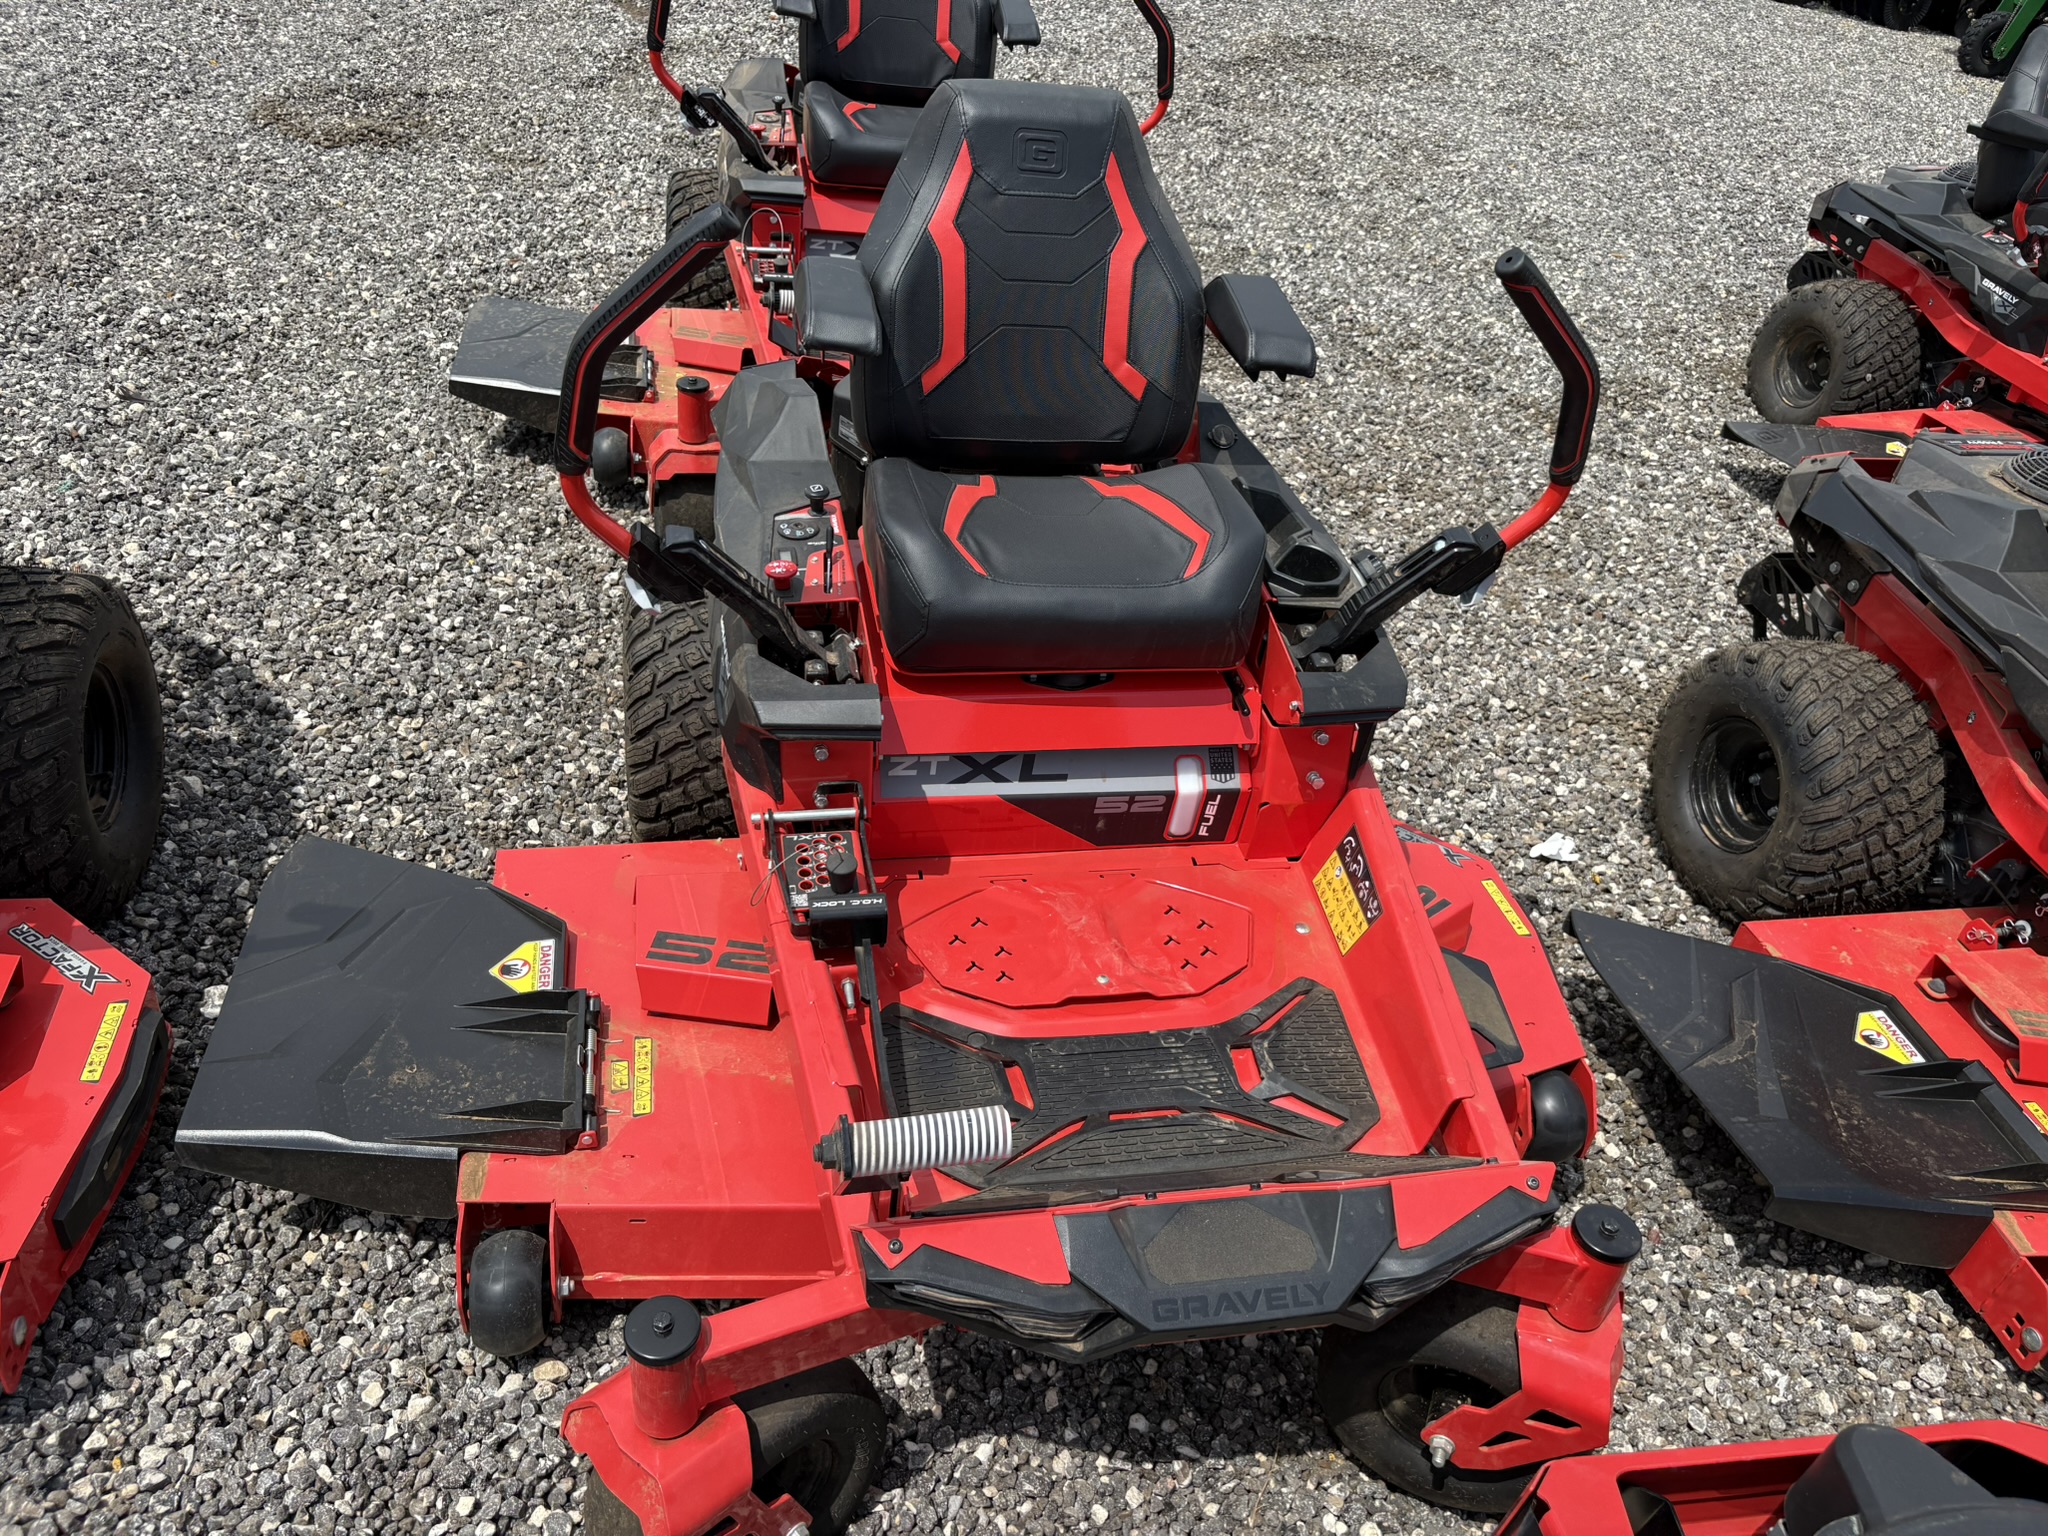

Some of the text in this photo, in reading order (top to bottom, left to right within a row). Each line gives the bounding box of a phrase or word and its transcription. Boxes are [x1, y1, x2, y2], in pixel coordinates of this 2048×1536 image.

[809, 239, 844, 250] ZT
[1982, 278, 2020, 305] GRAVELY
[888, 753, 1070, 785] ZT XL
[1094, 795, 1167, 814] 52
[1198, 794, 1221, 836] FUEL
[812, 898, 883, 908] H.O.C. LOCK
[8, 923, 121, 994] X-FACTOR
[539, 944, 553, 991] DANGER
[646, 930, 770, 975] 52
[1876, 1014, 1919, 1059] DANGER
[1152, 1281, 1331, 1323] GRAVELY
